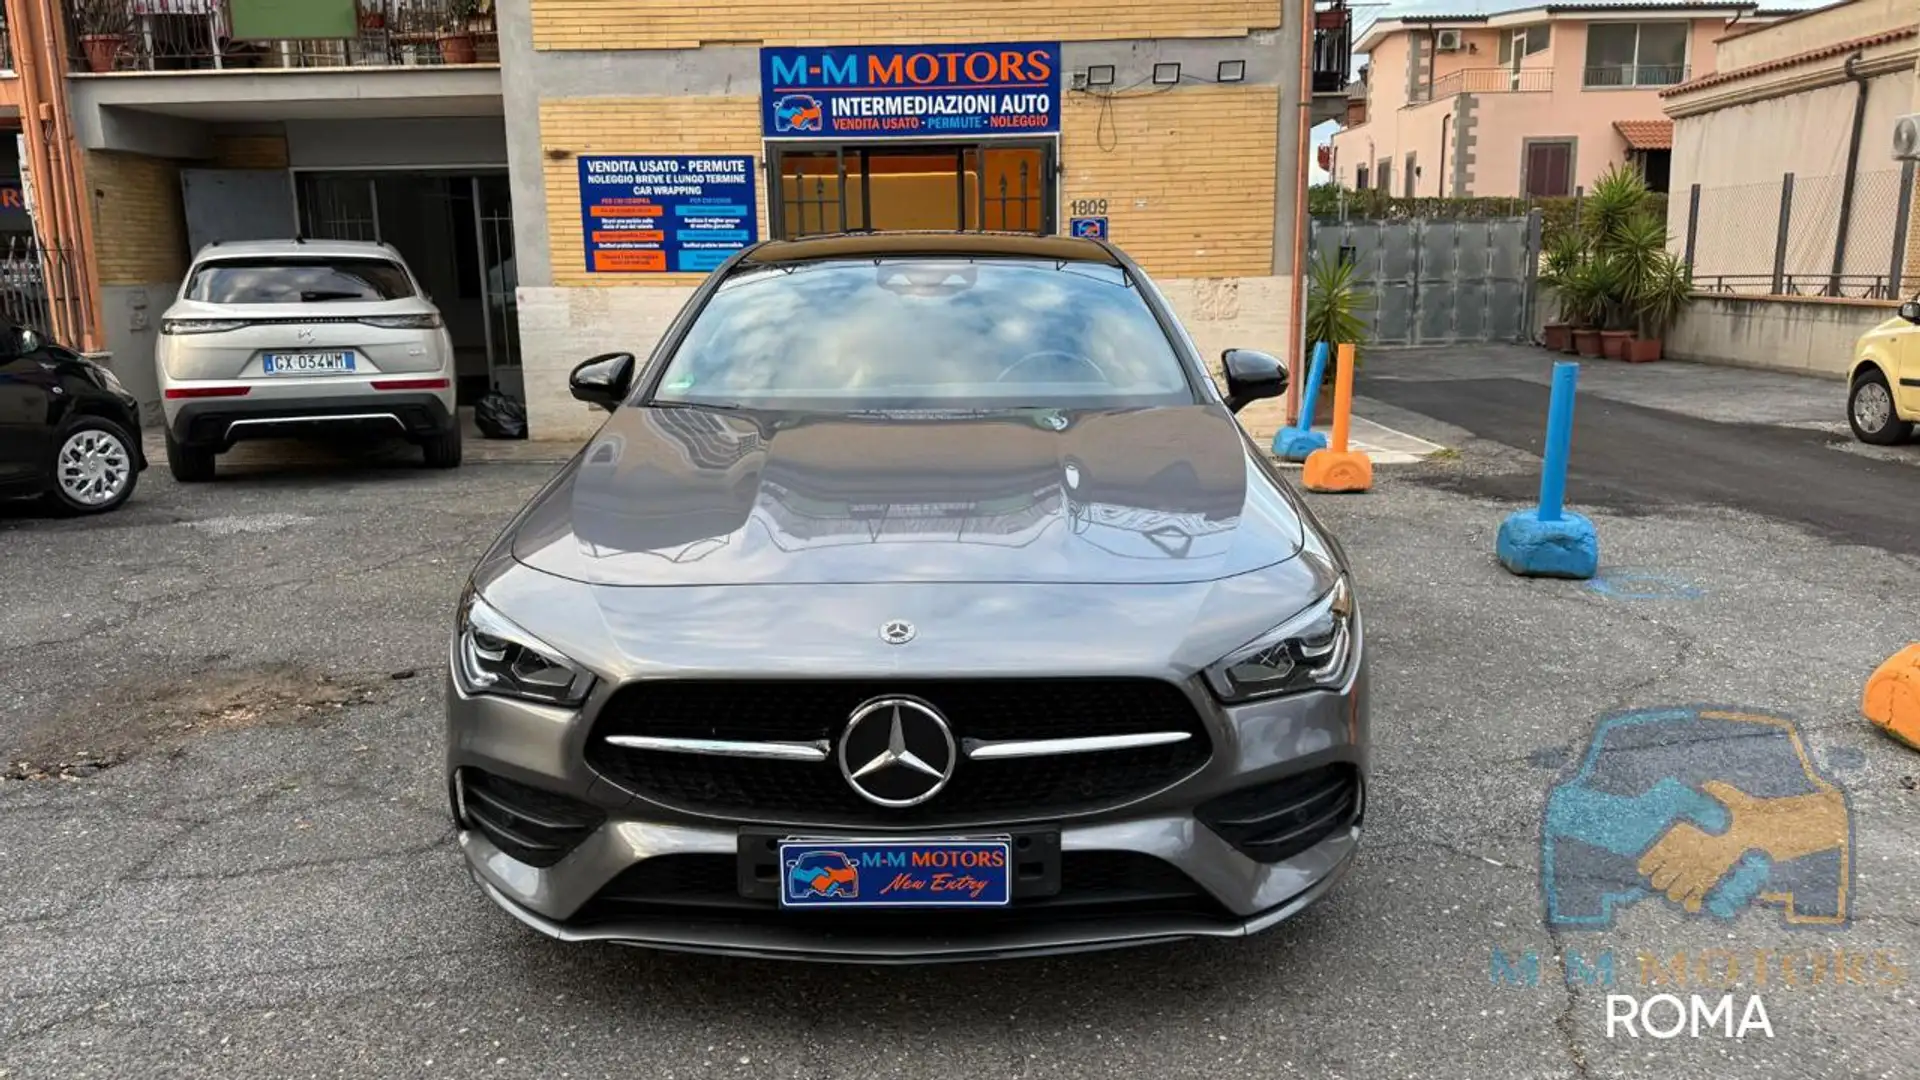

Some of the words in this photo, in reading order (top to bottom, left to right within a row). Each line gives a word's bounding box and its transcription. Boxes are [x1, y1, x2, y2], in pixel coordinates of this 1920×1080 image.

[771, 53, 858, 86] M-M
[868, 50, 1051, 85] MOTORS
[830, 95, 996, 117] INTERMEDIAZIONI
[1000, 94, 1050, 114] AUTO
[832, 118, 879, 131] VENDITA
[881, 117, 919, 130] USATO
[927, 115, 982, 129] PERMUTE
[989, 114, 1049, 128] NOLEGGIO
[587, 160, 637, 173] VENDITA
[640, 160, 679, 173] USATO
[688, 160, 745, 173] PERMUTE
[588, 174, 634, 184] NOLEGGIO
[635, 174, 665, 184] BREVE
[666, 174, 672, 184] E
[674, 174, 705, 184] LUNGO
[706, 174, 746, 184] TERMINE
[633, 186, 652, 196] CAR
[653, 185, 702, 196] WRAPPING
[1070, 199, 1108, 216] 1809
[862, 852, 906, 868] M-M
[911, 850, 1004, 868] MOTORS
[879, 872, 927, 895] New
[930, 873, 989, 898] Entry
